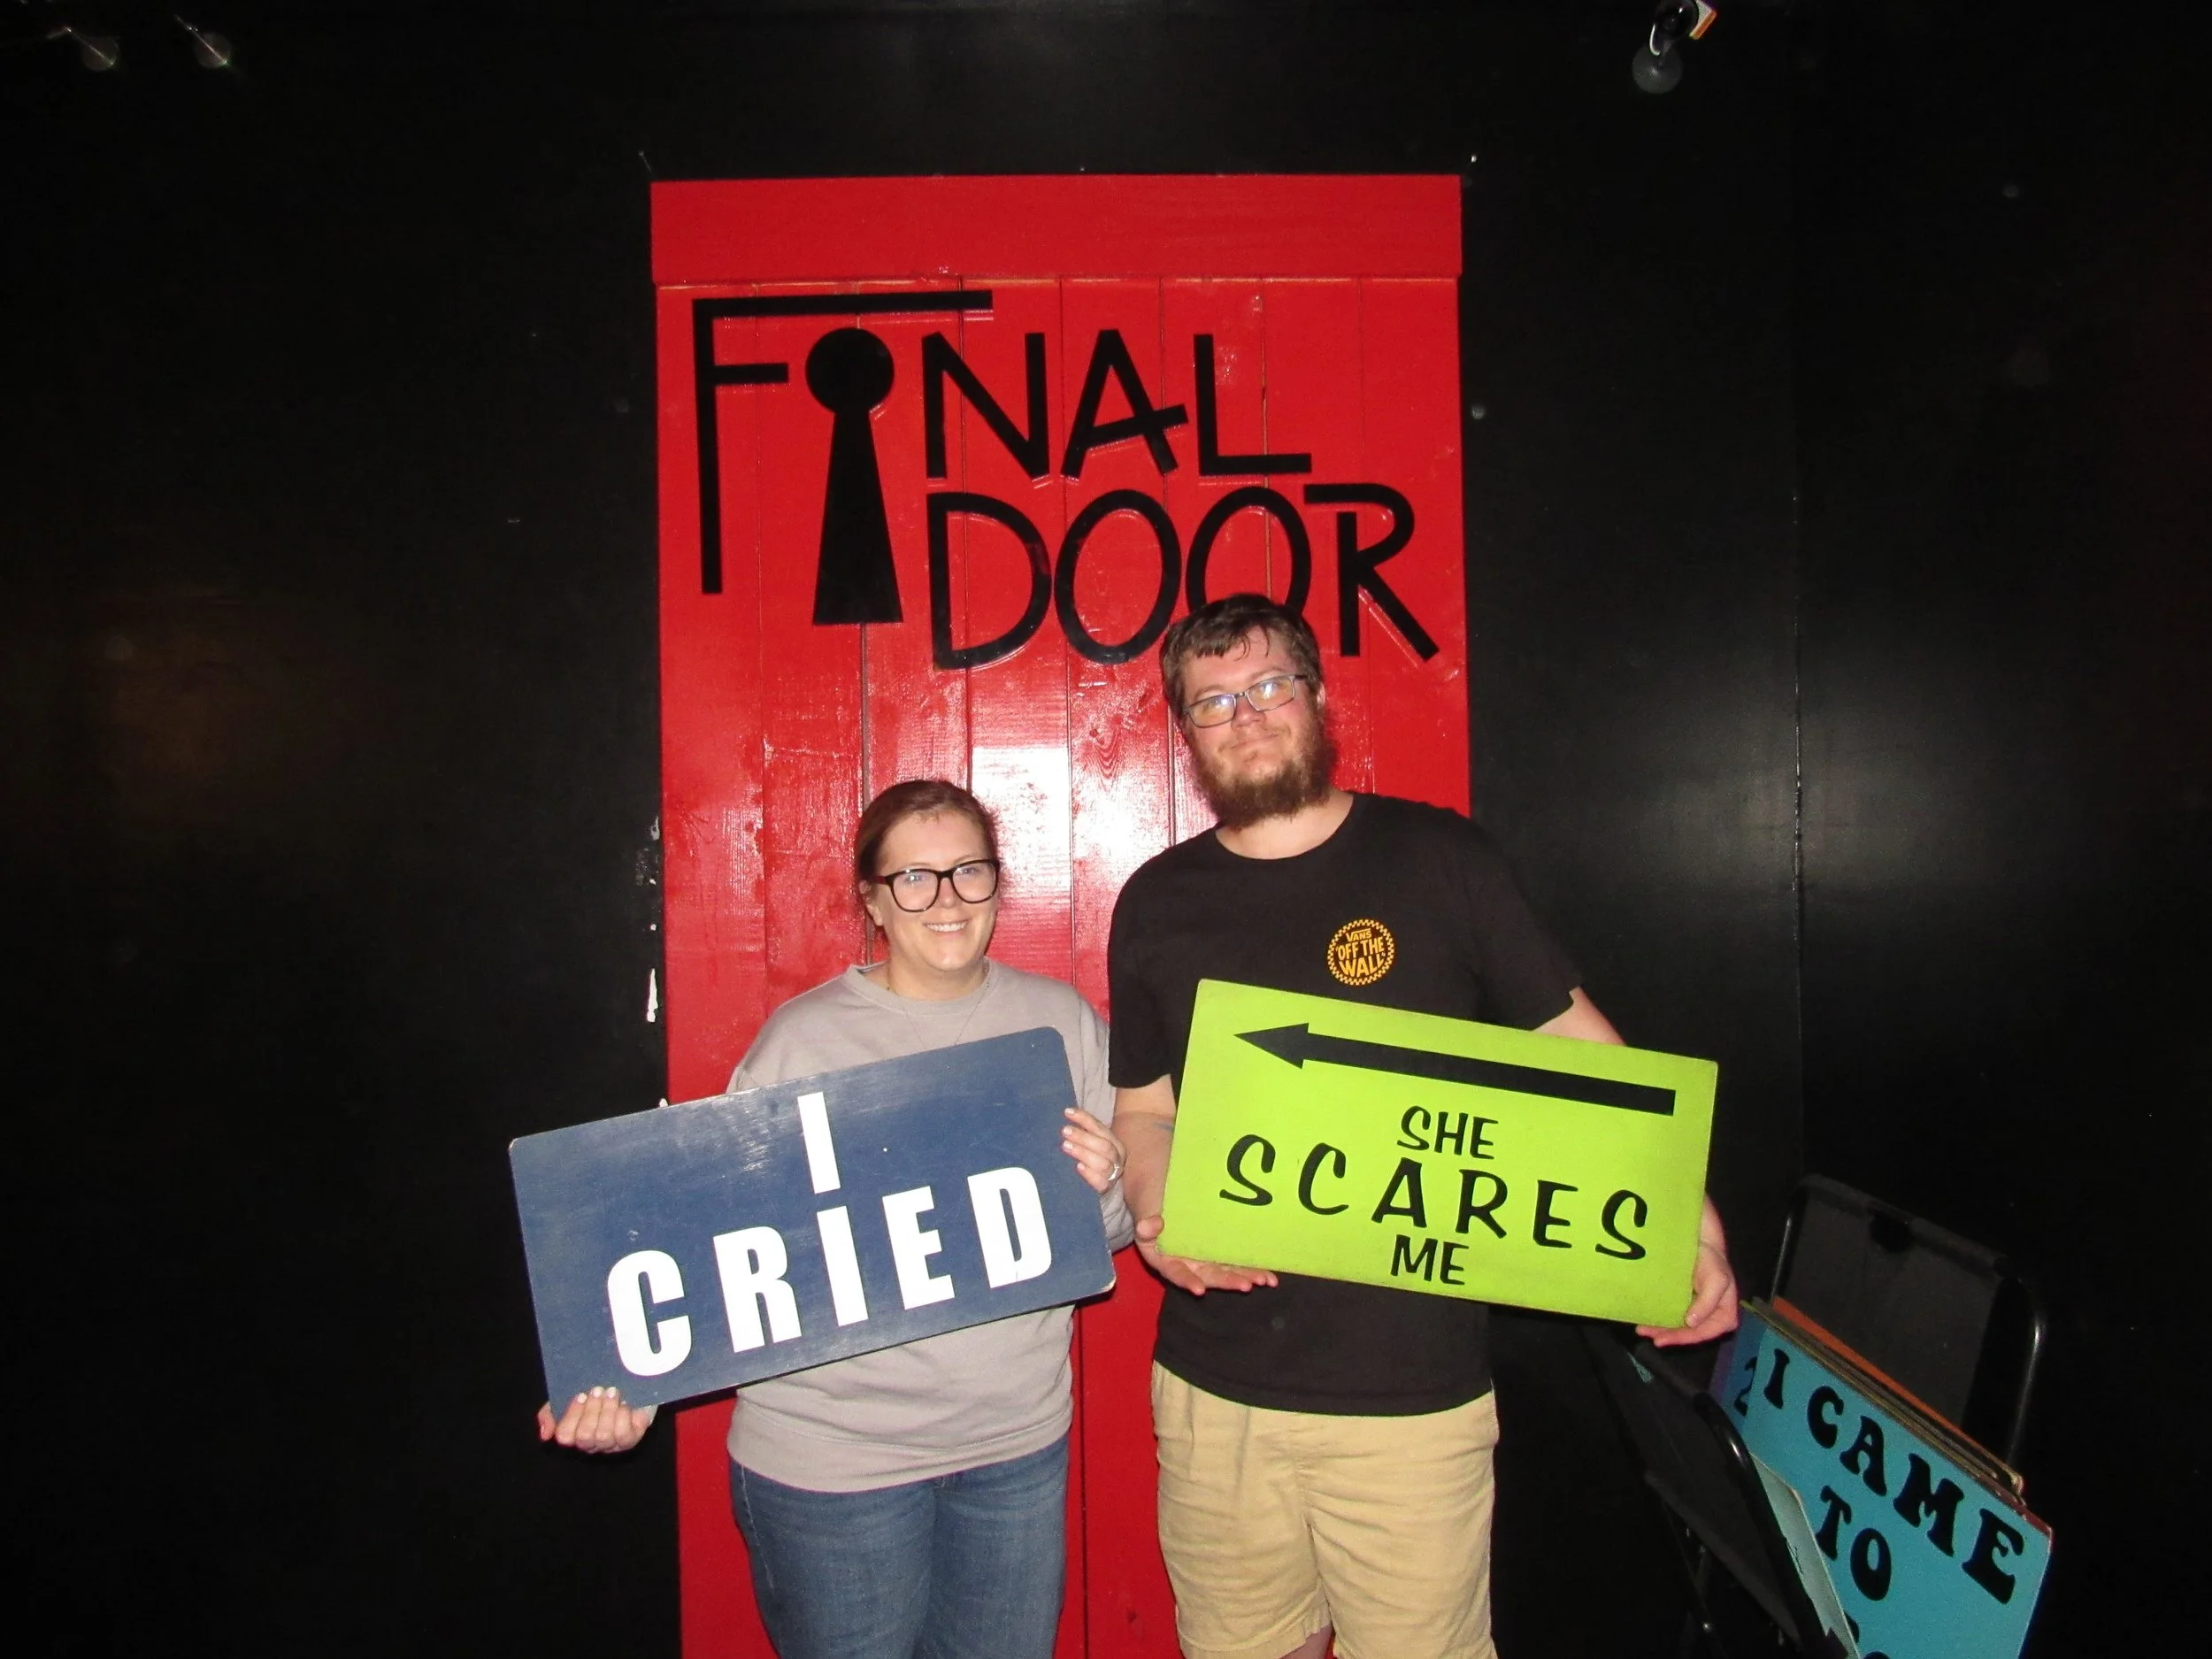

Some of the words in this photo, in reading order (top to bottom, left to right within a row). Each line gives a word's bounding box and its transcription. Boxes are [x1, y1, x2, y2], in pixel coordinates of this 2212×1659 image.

[927, 484, 1440, 671] DOOR
[1346, 928, 1371, 942] VANS
[1360, 936, 1385, 956] THE
[797, 1091, 841, 1194] I
[1396, 1105, 1498, 1159] SHE
[1219, 1134, 1647, 1260] SCARES
[607, 1167, 1052, 1377] CRIED
[1391, 1234, 1469, 1286] ME
[1763, 1348, 1790, 1409] I
[1807, 1386, 2024, 1603] CAME
[1816, 1485, 1892, 1601] TO
